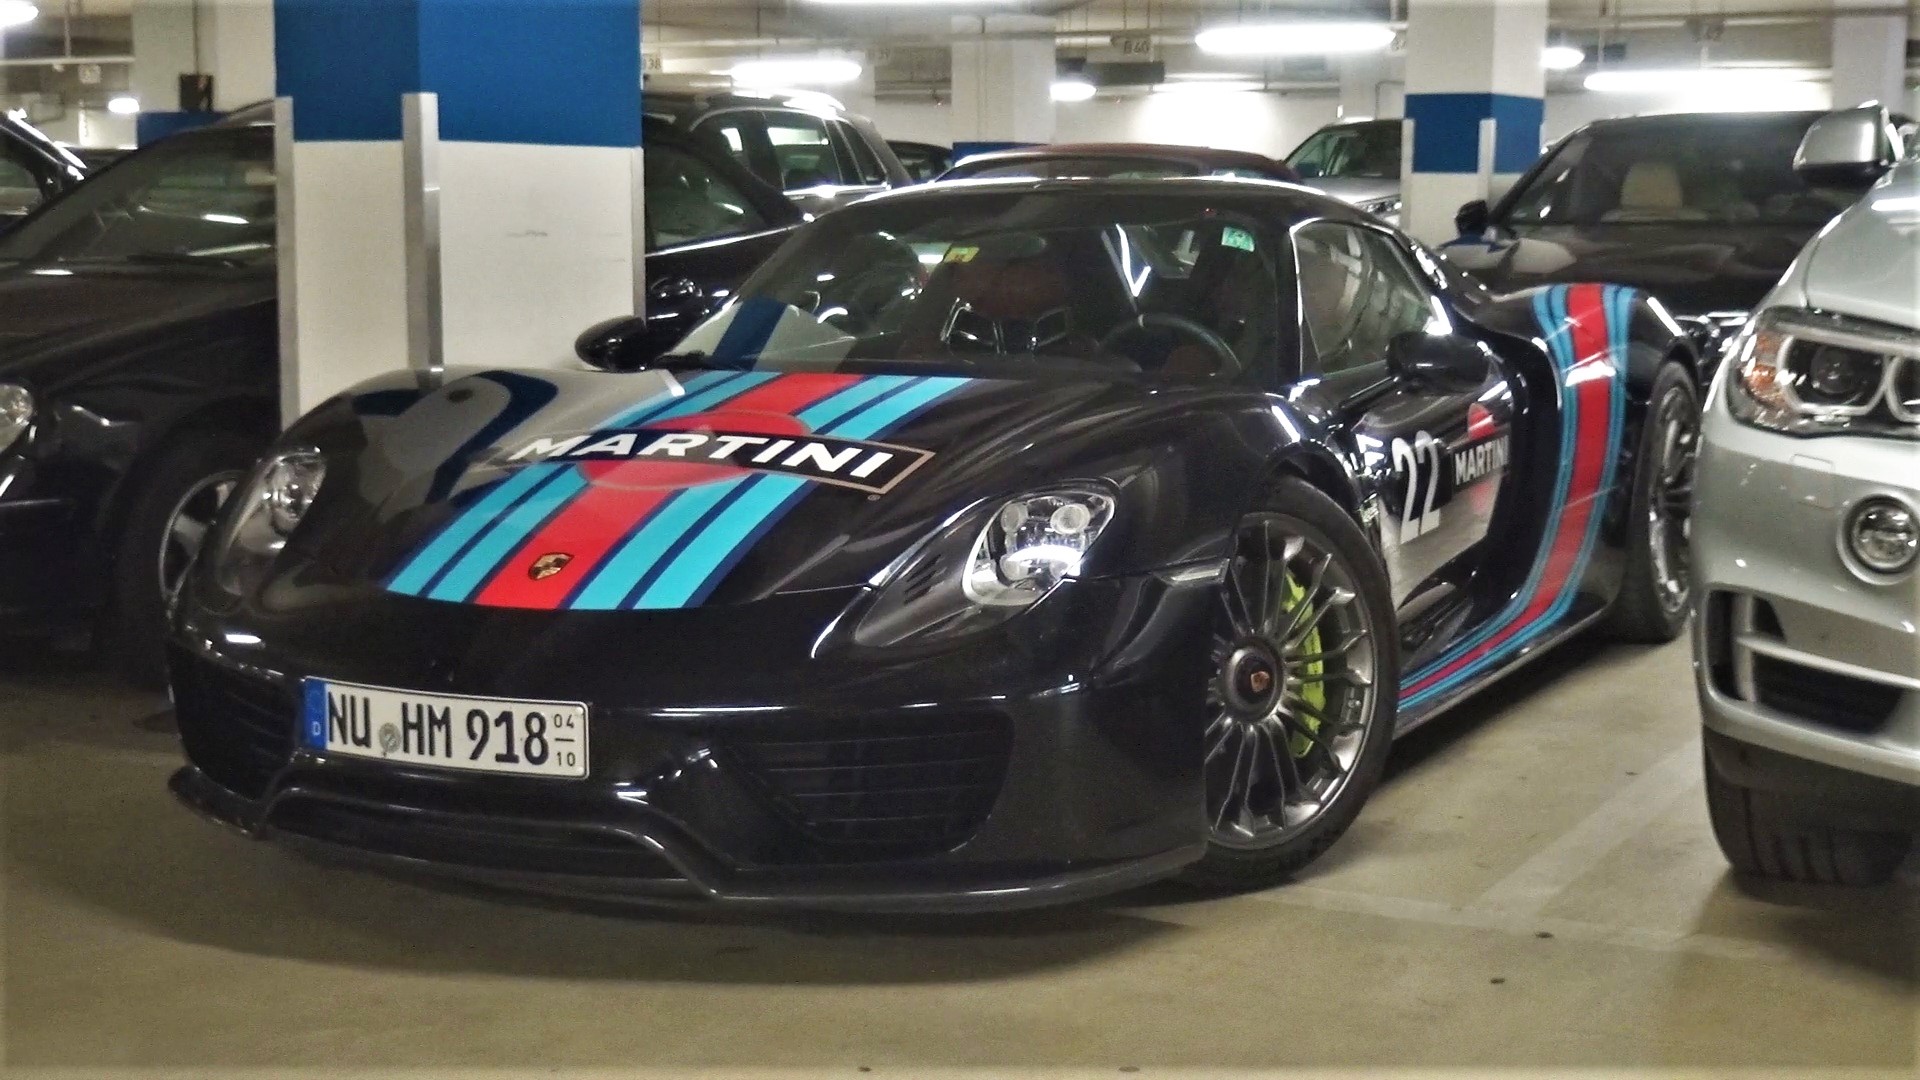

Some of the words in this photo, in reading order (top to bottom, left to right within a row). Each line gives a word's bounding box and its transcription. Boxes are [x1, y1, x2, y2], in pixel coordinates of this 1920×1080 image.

[507, 433, 893, 478] MARTINI
[1455, 435, 1509, 486] MARTINI
[1392, 430, 1440, 545] 22
[311, 721, 321, 736] D
[328, 691, 371, 748] NU
[402, 701, 451, 758] HM
[466, 708, 549, 766] 918
[554, 713, 575, 728] 04
[556, 752, 576, 767] 10
